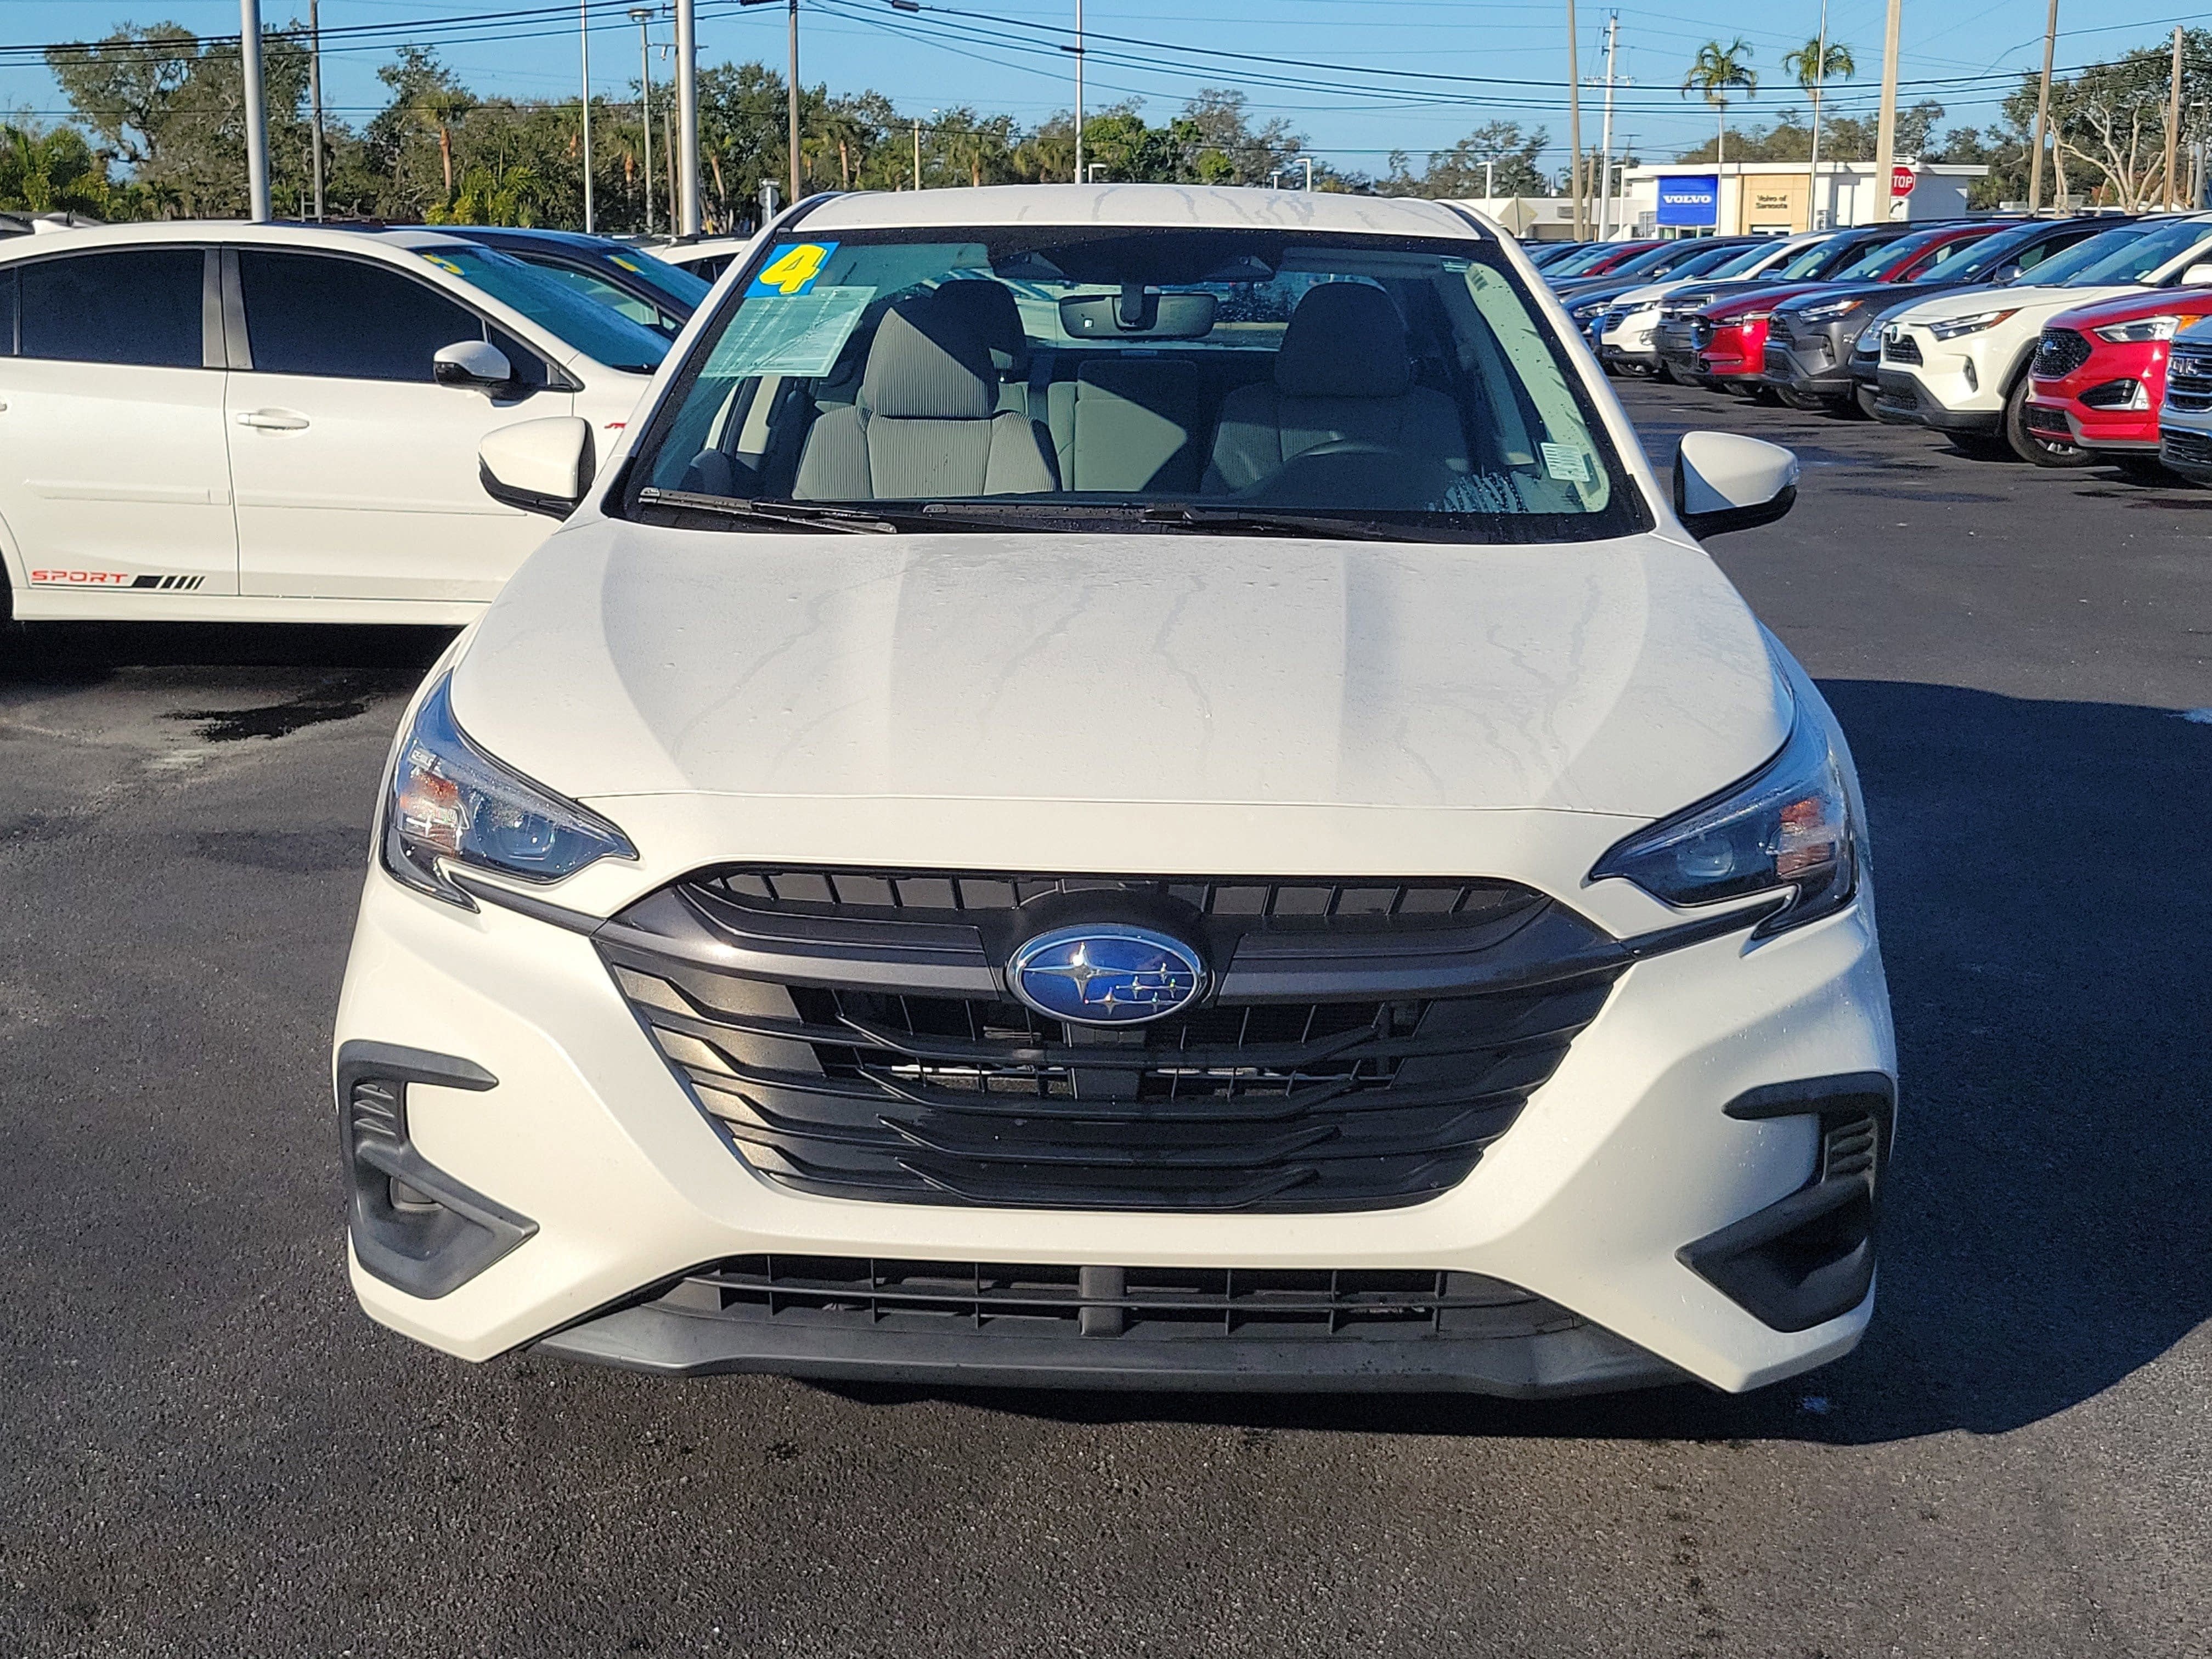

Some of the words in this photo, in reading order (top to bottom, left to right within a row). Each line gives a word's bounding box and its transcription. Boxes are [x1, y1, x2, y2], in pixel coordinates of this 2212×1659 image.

[1893, 176, 1913, 188] TOP
[1663, 195, 1712, 204] VOLVO
[759, 244, 827, 295] 4
[32, 571, 128, 583] SPORT
